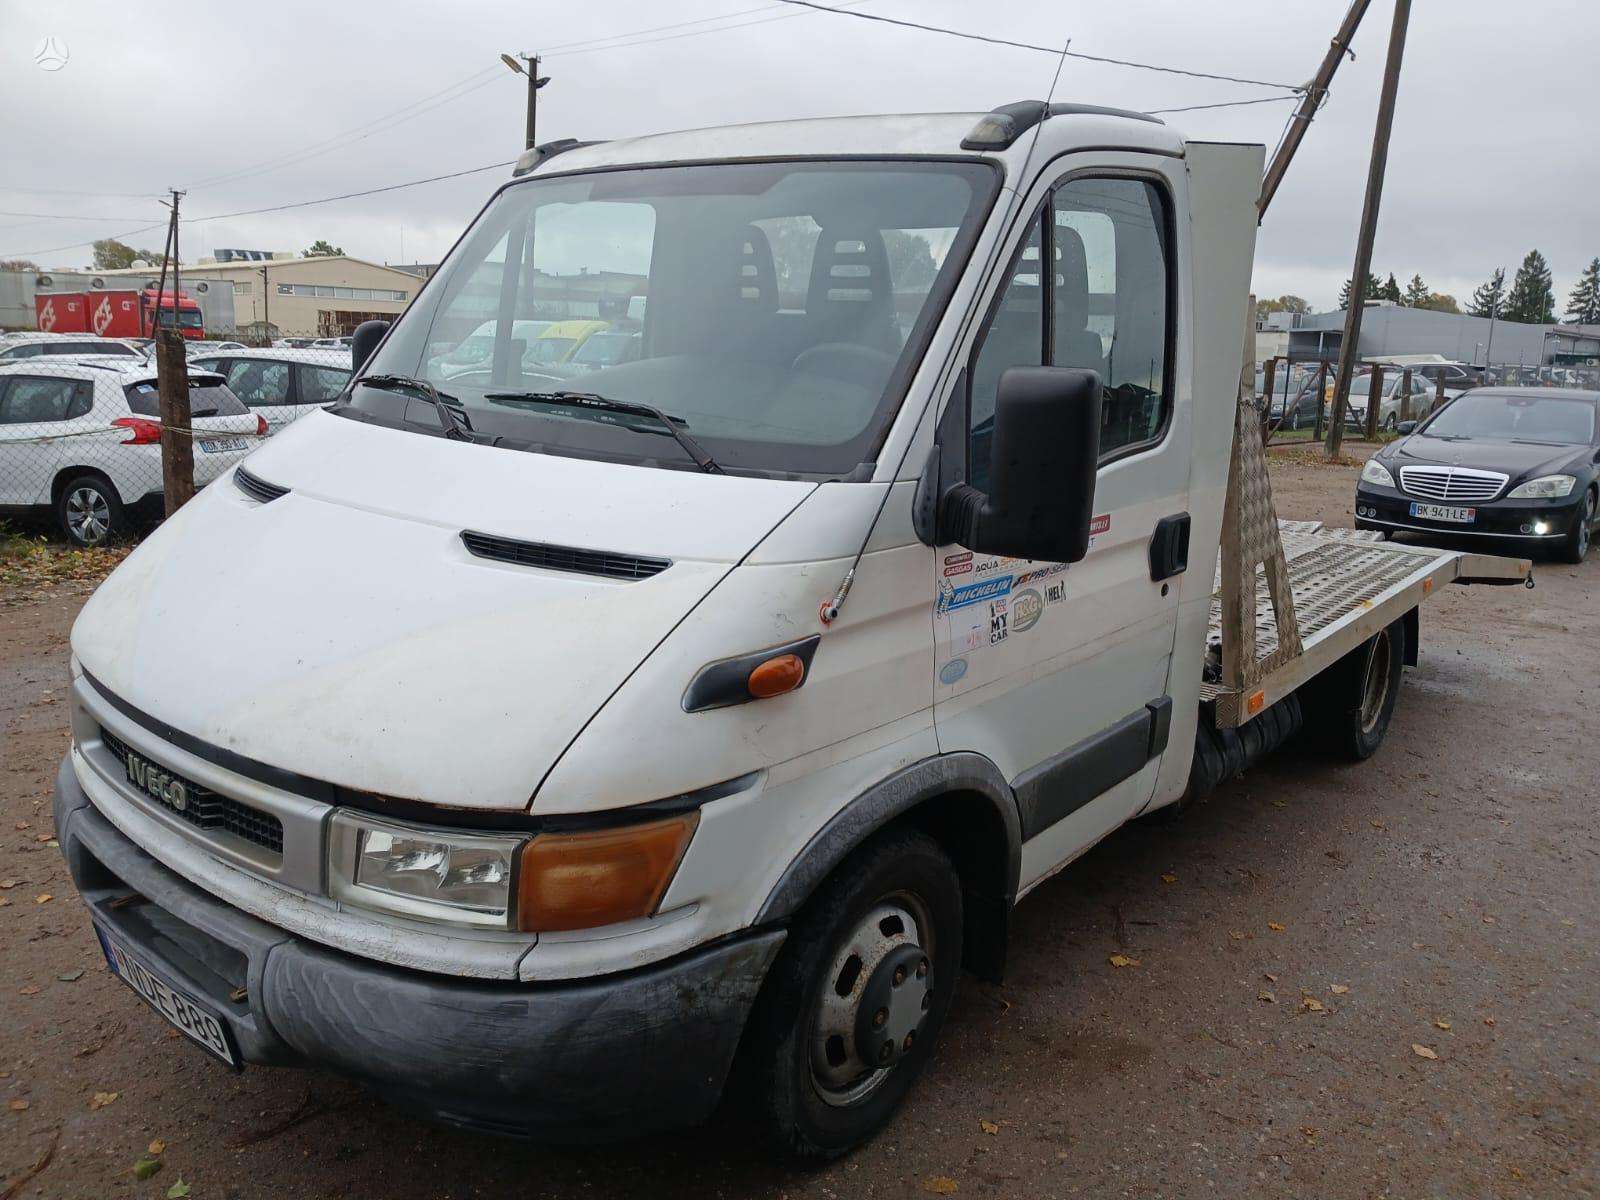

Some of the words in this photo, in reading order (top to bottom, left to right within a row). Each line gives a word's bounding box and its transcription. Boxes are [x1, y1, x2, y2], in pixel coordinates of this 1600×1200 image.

[975, 560, 999, 573] AQUA
[953, 579, 1012, 604] MICHELIN
[990, 612, 1008, 634] MY
[990, 629, 1009, 644] CAR
[128, 753, 186, 811] IVECO
